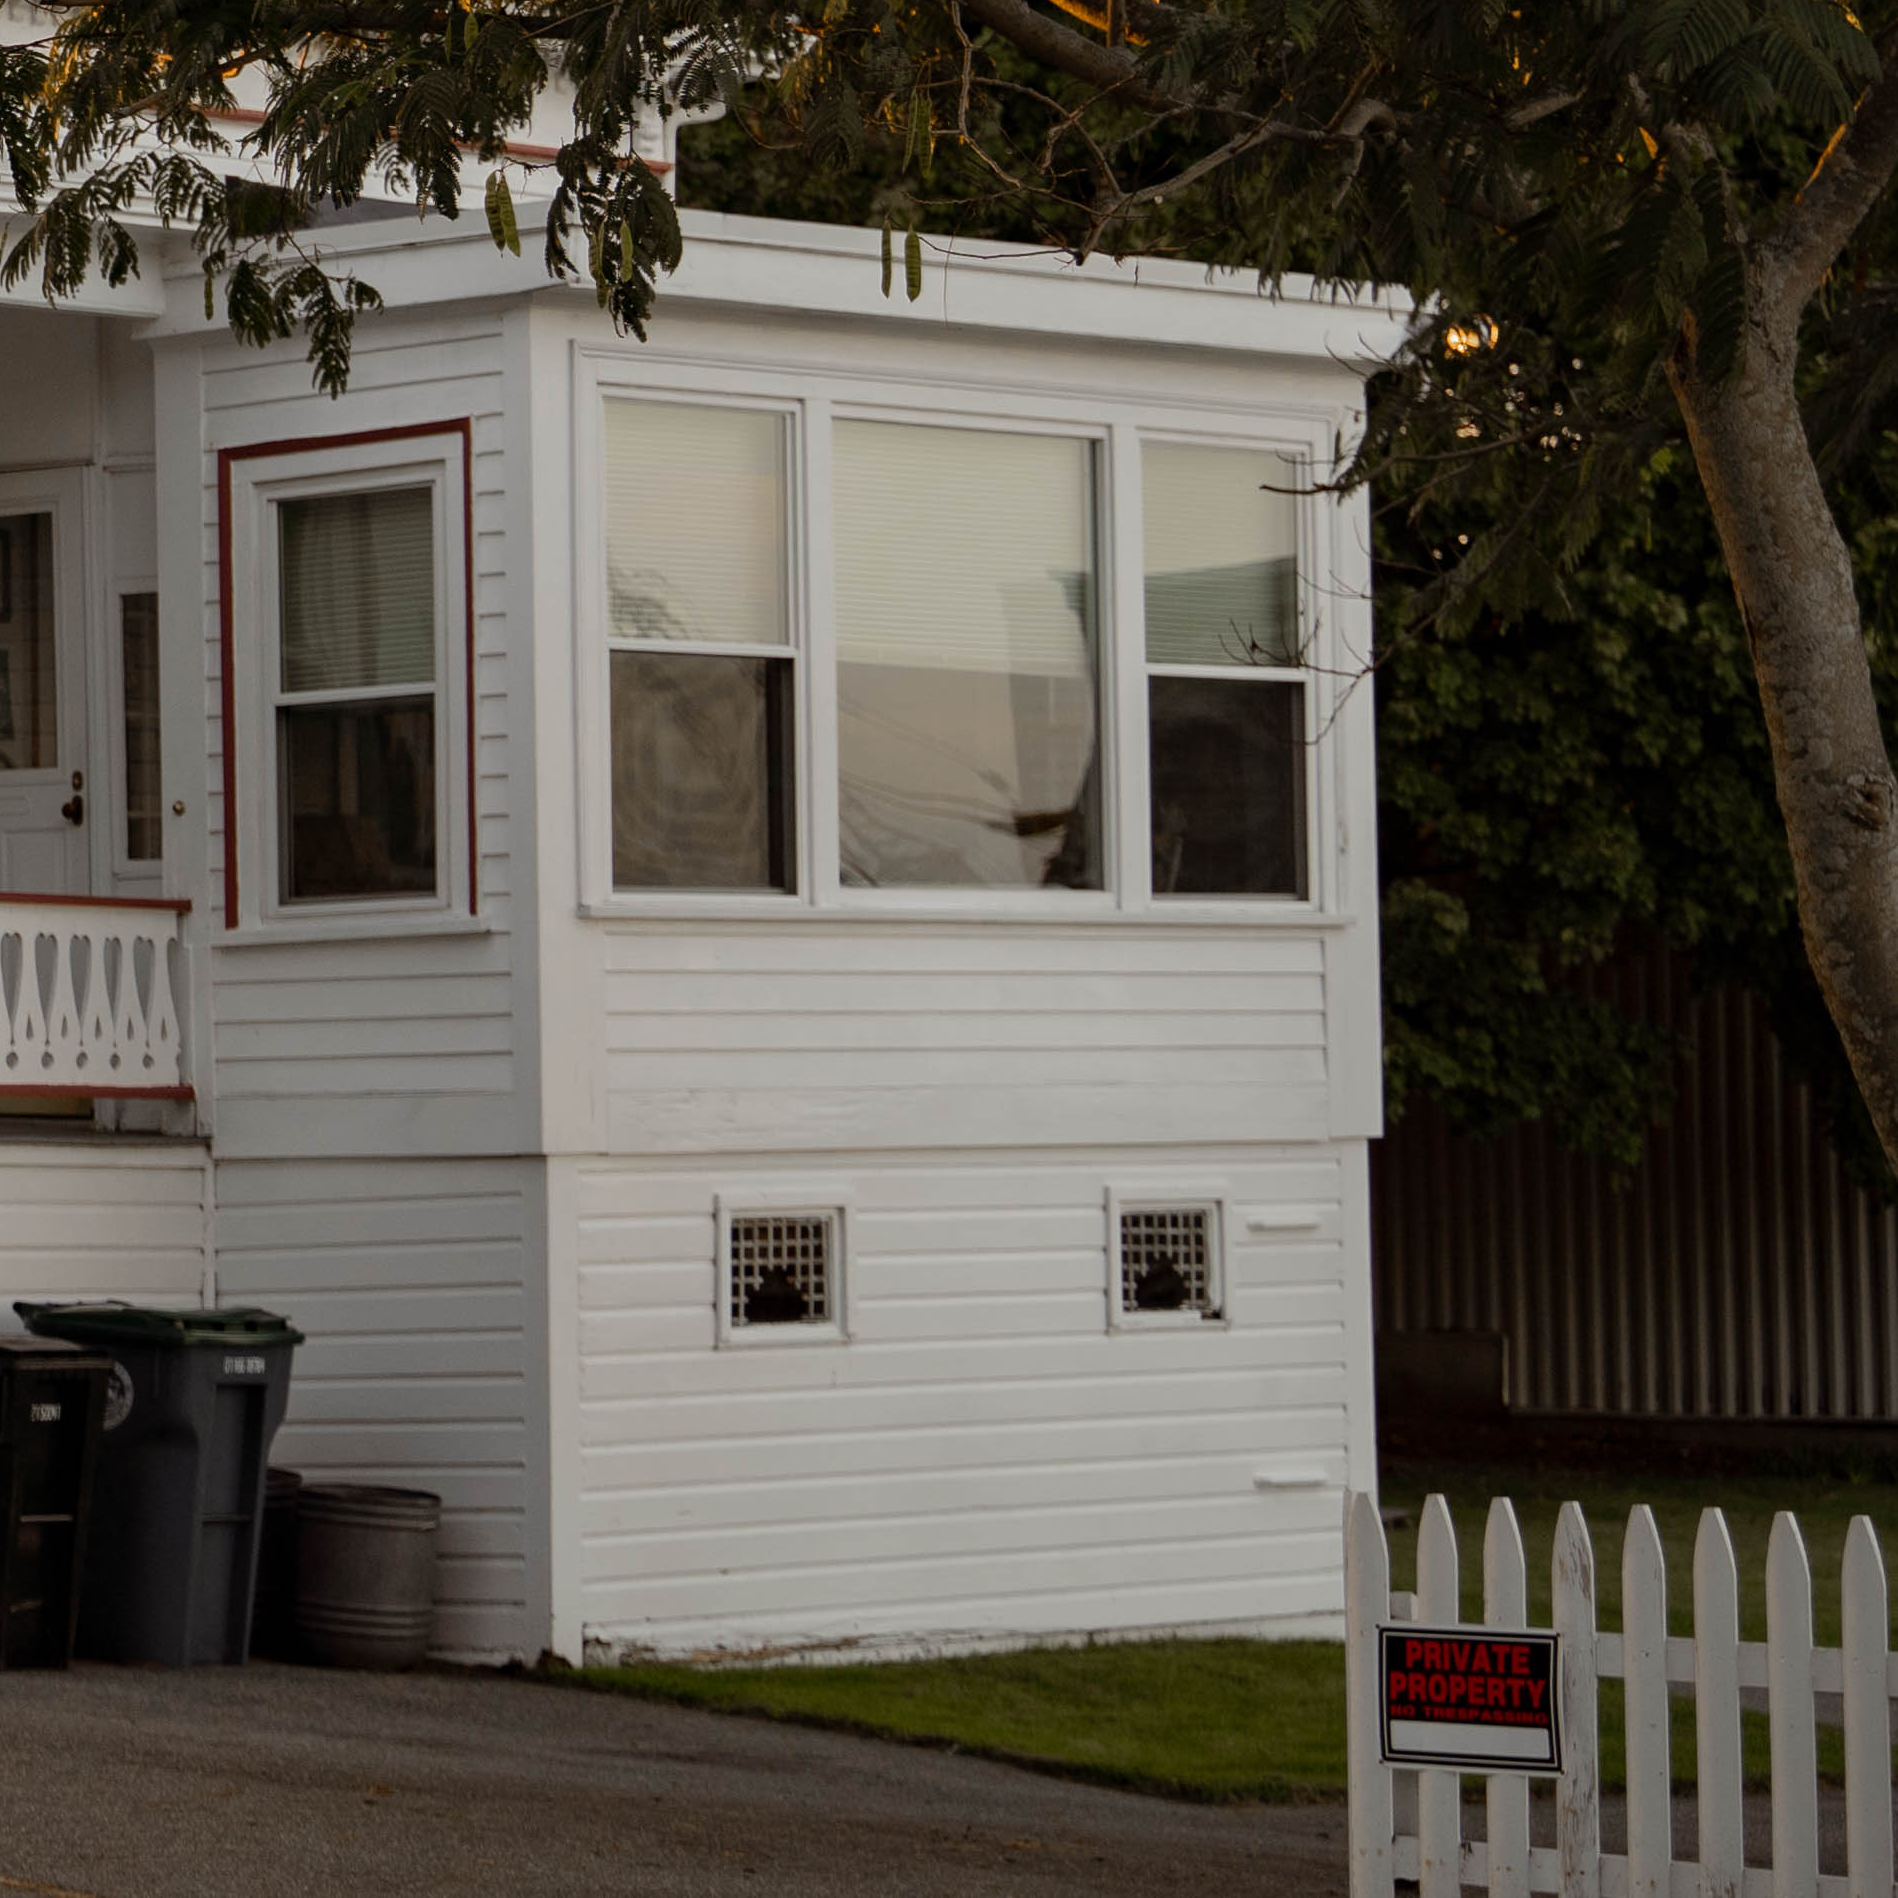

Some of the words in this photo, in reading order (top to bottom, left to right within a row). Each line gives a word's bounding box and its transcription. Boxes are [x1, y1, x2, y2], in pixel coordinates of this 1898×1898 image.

[1405, 1639, 1531, 1675] PRIVATE
[1389, 1670, 1546, 1709] PROPERTY
[1390, 1704, 1416, 1717] NO
[1423, 1706, 1548, 1724] TRESPASSING
